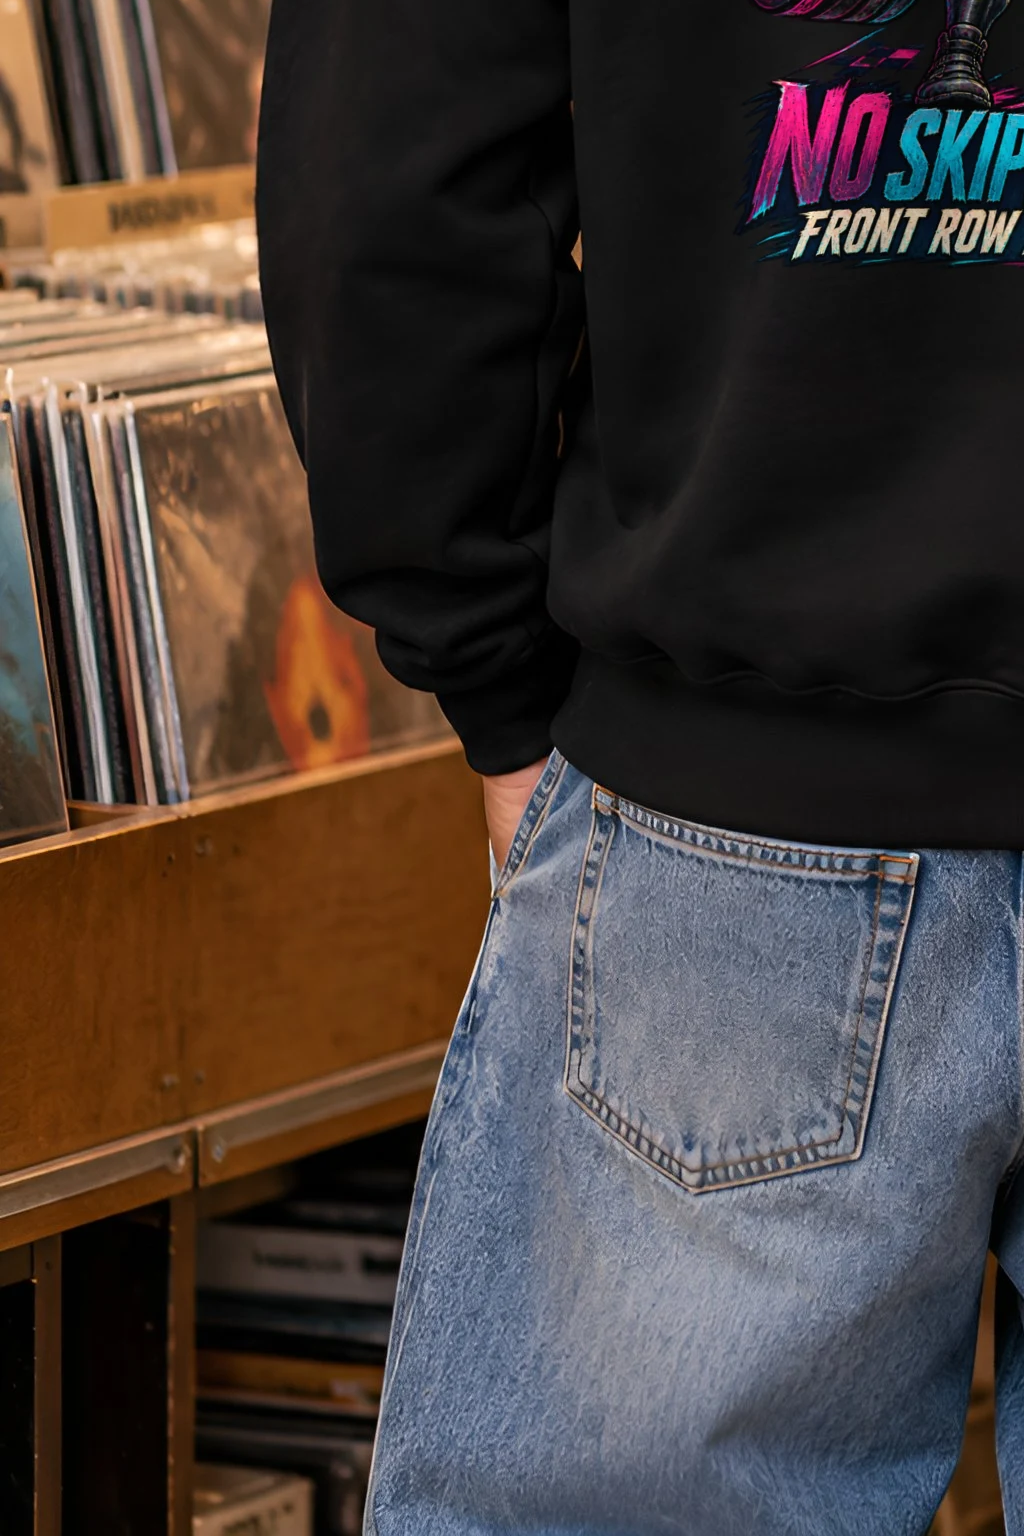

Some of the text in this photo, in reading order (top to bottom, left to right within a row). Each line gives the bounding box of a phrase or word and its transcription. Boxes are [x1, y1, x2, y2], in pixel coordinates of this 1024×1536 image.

[750, 77, 893, 220] NO
[790, 207, 932, 262] FRONT
[929, 207, 1023, 256] ROW
